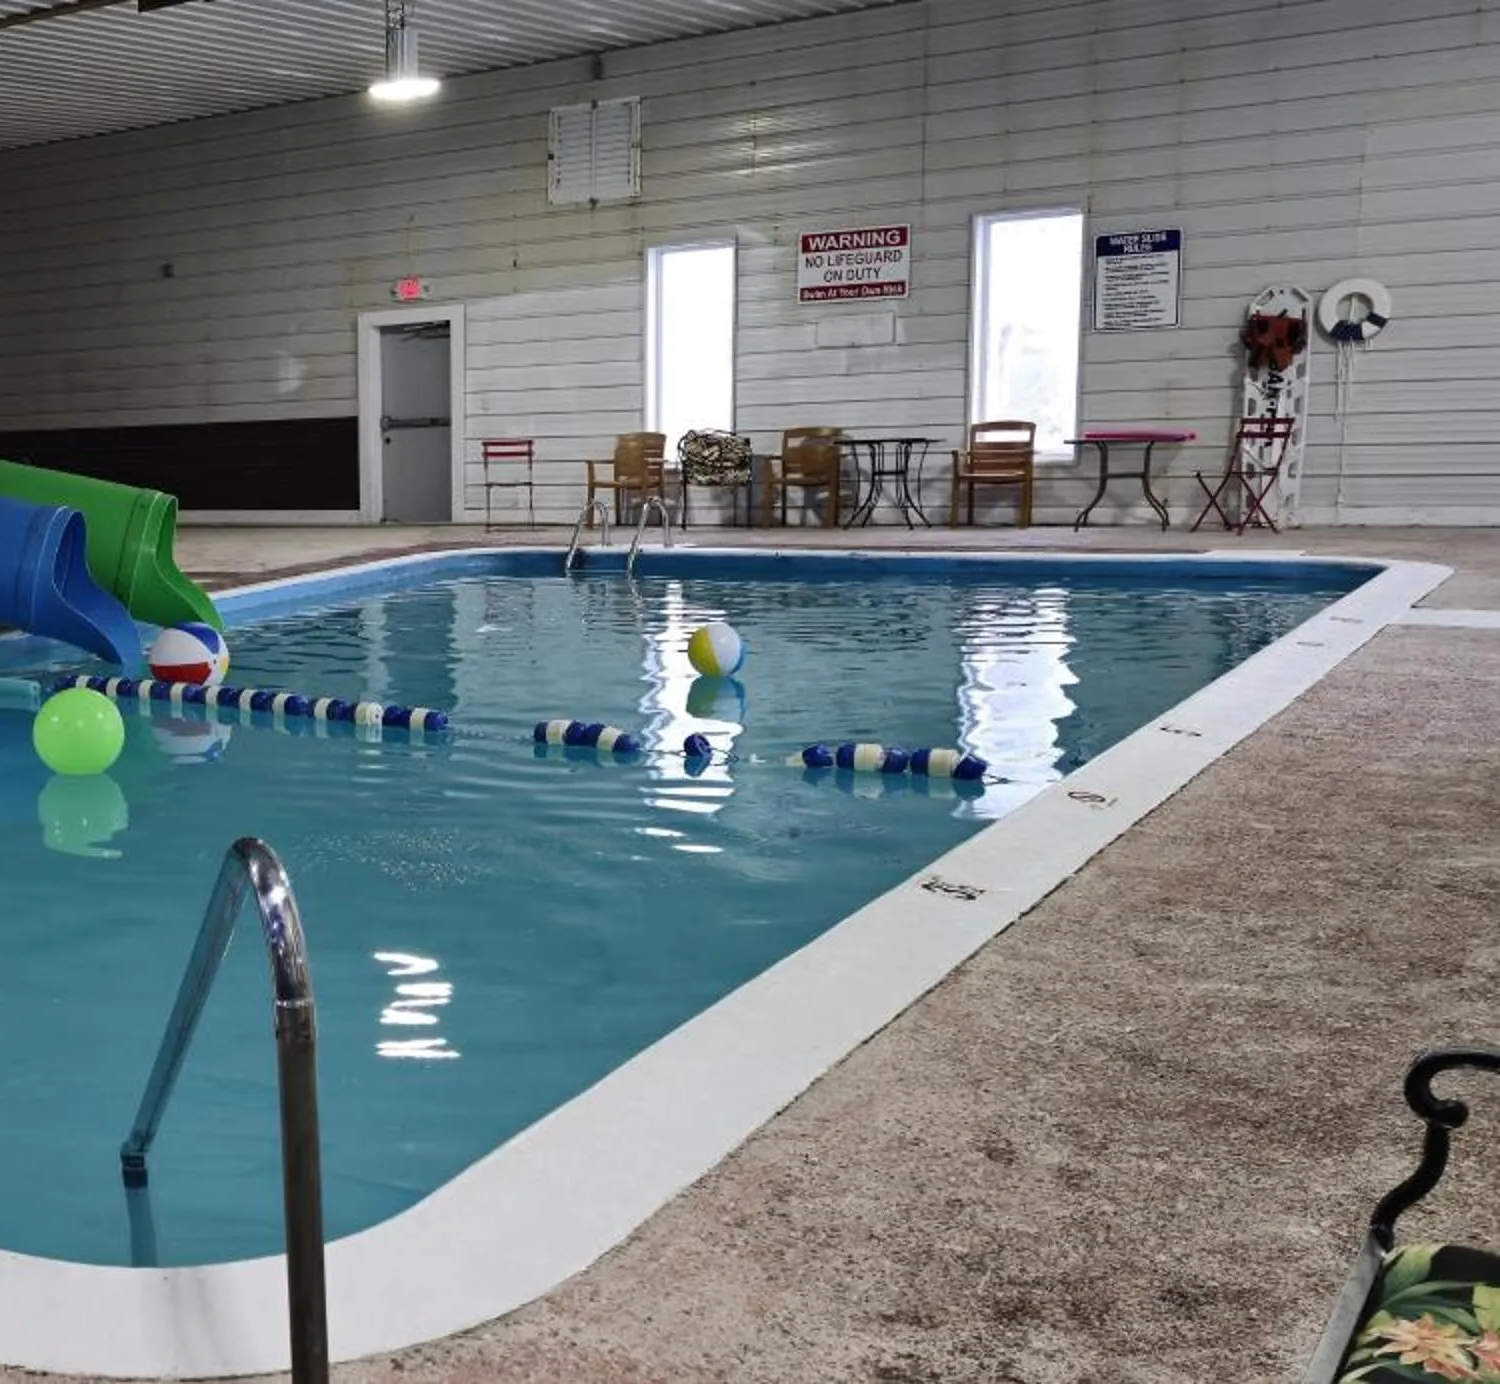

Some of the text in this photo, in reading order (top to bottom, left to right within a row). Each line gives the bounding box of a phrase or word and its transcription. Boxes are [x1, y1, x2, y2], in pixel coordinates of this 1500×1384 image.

[808, 229, 901, 251] WARNING
[805, 249, 903, 268] NO LIFEGUARD
[823, 267, 881, 283] ON DUTY
